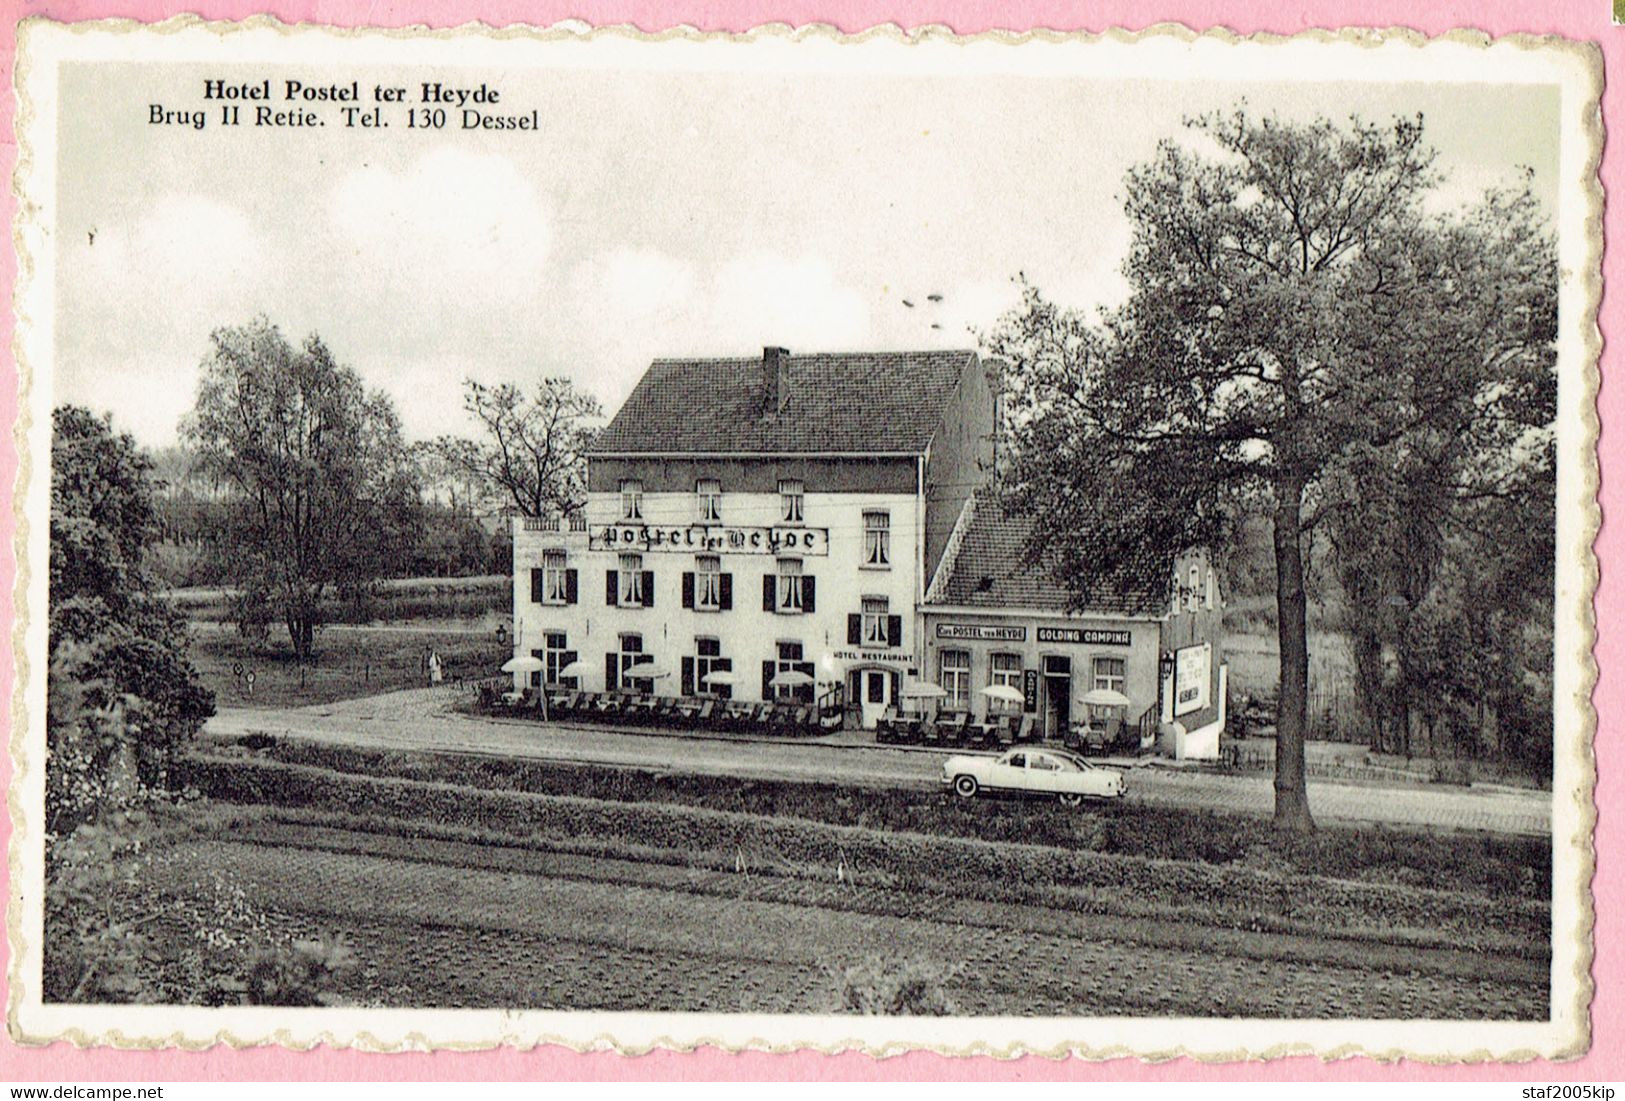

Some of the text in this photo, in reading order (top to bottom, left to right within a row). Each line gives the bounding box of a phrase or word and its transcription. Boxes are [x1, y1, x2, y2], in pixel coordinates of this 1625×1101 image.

[953, 627, 983, 637] POSTEL
[996, 629, 1023, 639] HEYDE
[1039, 629, 1080, 641] GOLDING
[833, 651, 914, 662] HOTEL RESTAURANT
